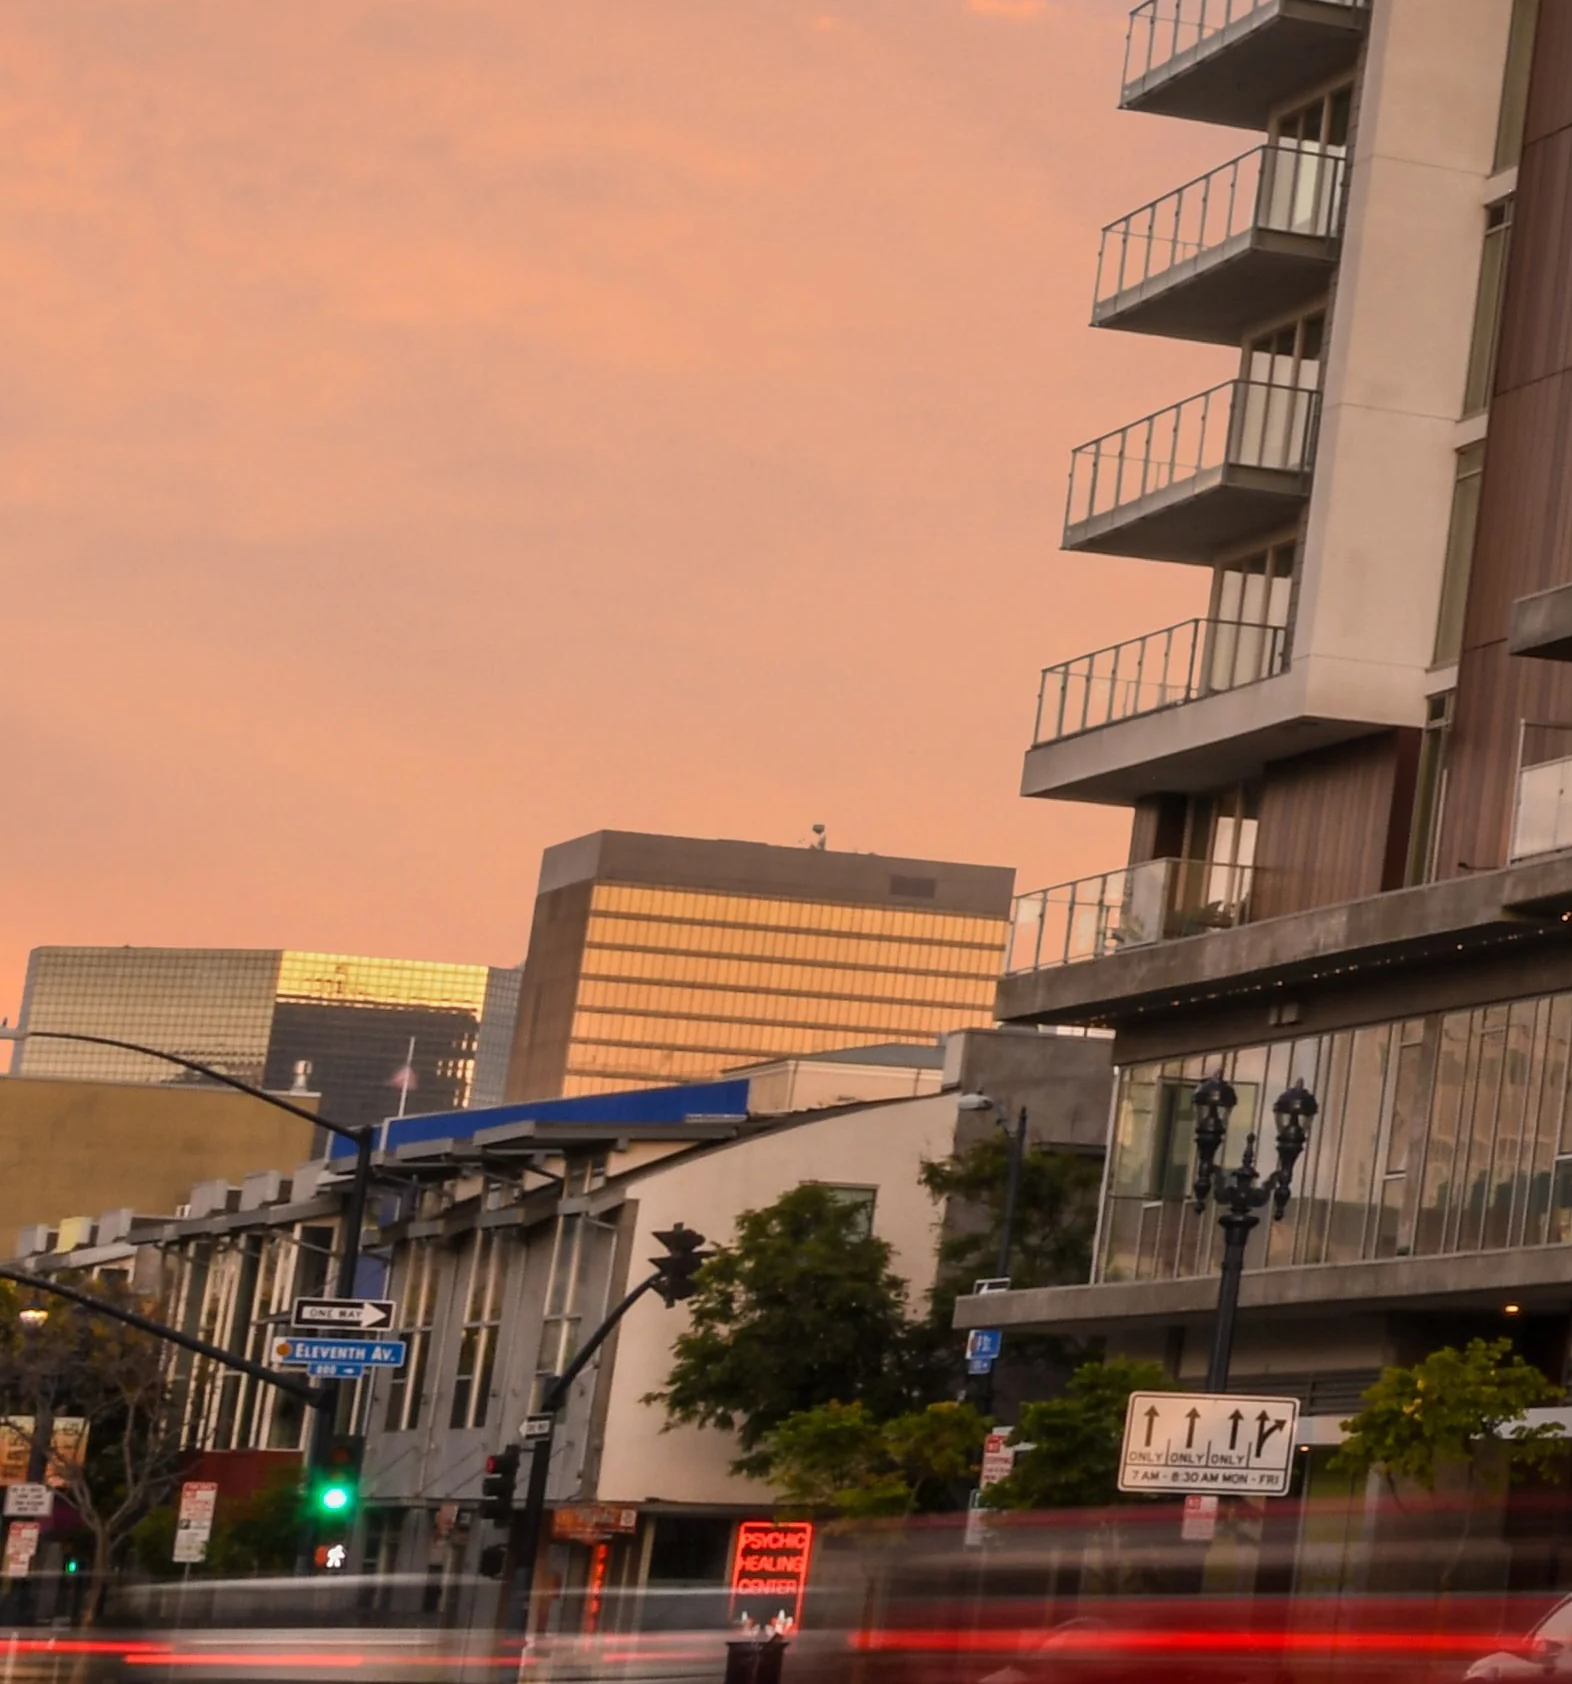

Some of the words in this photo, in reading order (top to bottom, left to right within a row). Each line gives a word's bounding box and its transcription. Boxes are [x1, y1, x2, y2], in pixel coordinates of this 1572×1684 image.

[295, 1342, 367, 1361] ELEVENTH
[1128, 1451, 1163, 1463] ONLY
[1170, 1451, 1205, 1464] ONLY
[1210, 1453, 1245, 1465] ONLY
[1222, 1472, 1248, 1484] MON
[1258, 1475, 1279, 1486] FRI
[743, 1532, 807, 1550] PSYCHIC
[739, 1554, 805, 1573] HEALING
[738, 1578, 798, 1595] CENTER
